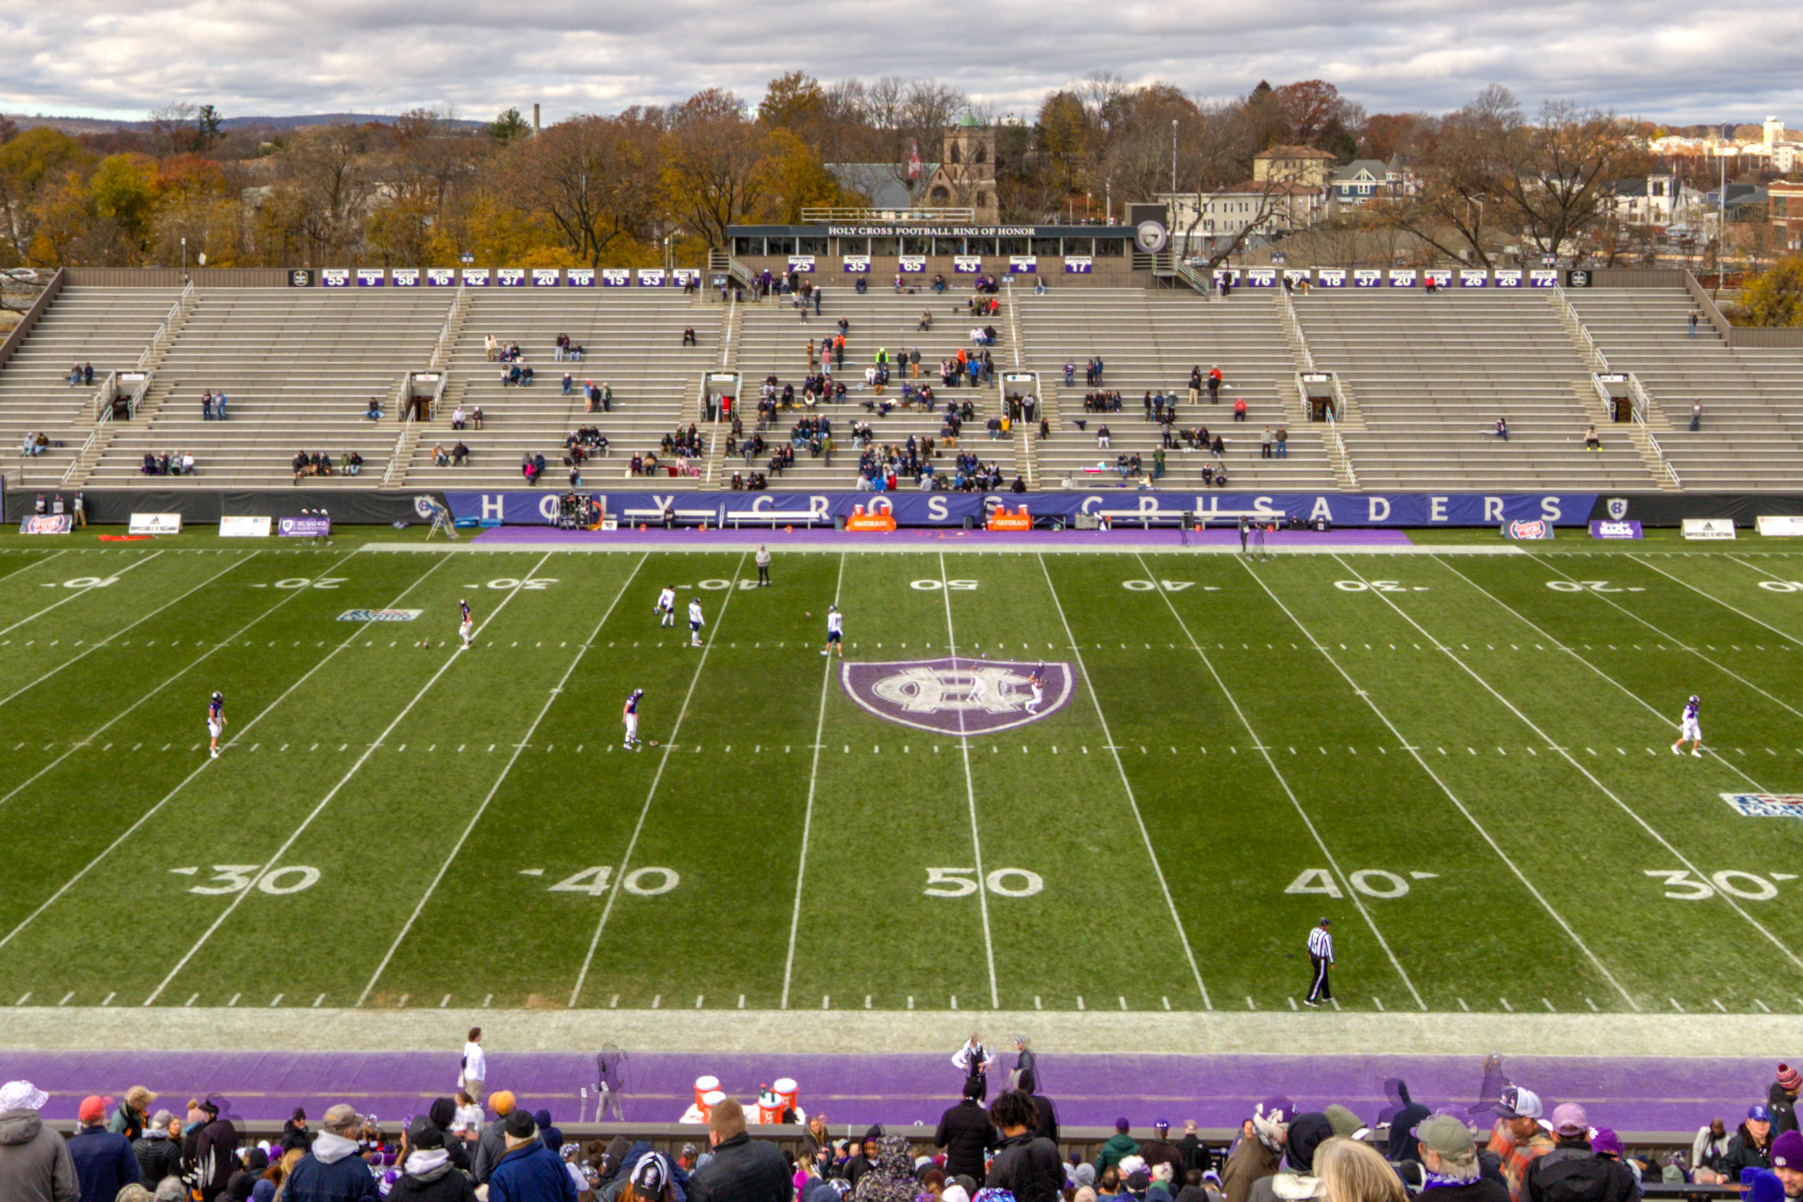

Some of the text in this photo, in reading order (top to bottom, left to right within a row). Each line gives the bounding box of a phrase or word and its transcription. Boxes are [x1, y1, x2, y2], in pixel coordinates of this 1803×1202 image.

[828, 226, 1036, 236] HOLY CROSS FOOTBALL RING OF HONOR
[794, 261, 811, 272] 25
[849, 261, 866, 272] 35
[904, 261, 921, 272] 65
[959, 261, 976, 272] 43
[1018, 261, 1028, 272] 4
[1072, 261, 1086, 272] 17
[328, 275, 344, 286] 55
[367, 275, 375, 286] 9
[398, 275, 415, 286] 58
[433, 275, 449, 286] 16
[467, 275, 485, 286] 42
[503, 275, 519, 286] 37
[537, 275, 554, 286] 20
[573, 275, 589, 286] 18
[608, 275, 625, 286] 15
[643, 275, 660, 286] 53
[1255, 276, 1270, 287] 76
[1326, 276, 1341, 287] 18
[1359, 276, 1375, 287] 37
[1394, 276, 1411, 287] 20
[1465, 276, 1482, 287] 26
[1500, 276, 1517, 287] 26
[1537, 276, 1552, 287] 72
[187, 864, 321, 895] 30
[548, 866, 680, 896] 40
[924, 866, 1045, 897] 50
[1284, 867, 1410, 899] 40
[1644, 869, 1779, 900] 30
